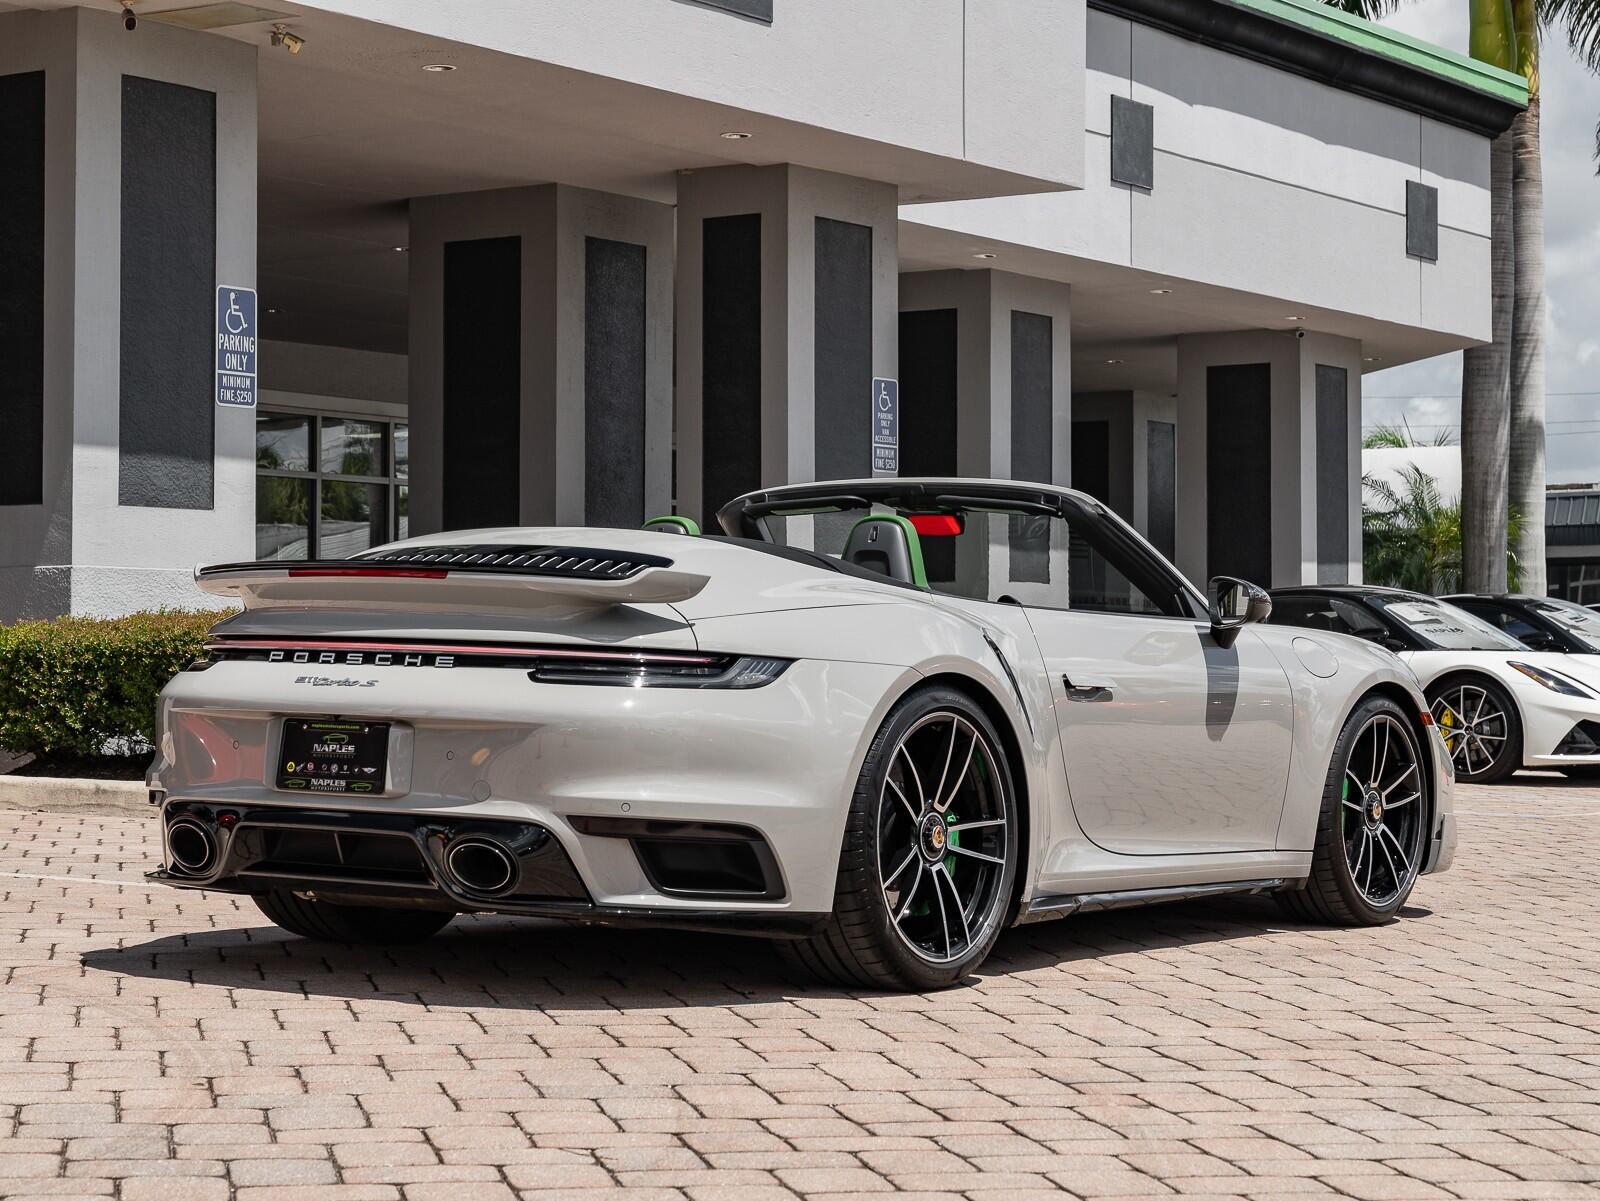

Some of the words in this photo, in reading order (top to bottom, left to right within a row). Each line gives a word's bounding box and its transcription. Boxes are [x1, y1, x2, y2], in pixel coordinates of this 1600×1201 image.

[218, 333, 255, 353] PARKING
[225, 353, 248, 371] ONLY
[222, 375, 251, 389] MINIMUM
[220, 389, 235, 401] FINE
[236, 390, 252, 403] $250
[877, 412, 894, 421] PARKING
[875, 435, 896, 443] ACCESSIBLE
[876, 448, 895, 458] MINIMUM
[875, 458, 884, 469] FINE
[885, 459, 896, 469] $250
[269, 651, 455, 667] PORSCHE
[313, 743, 355, 753] NAPLES
[310, 778, 346, 787] NAPLES
